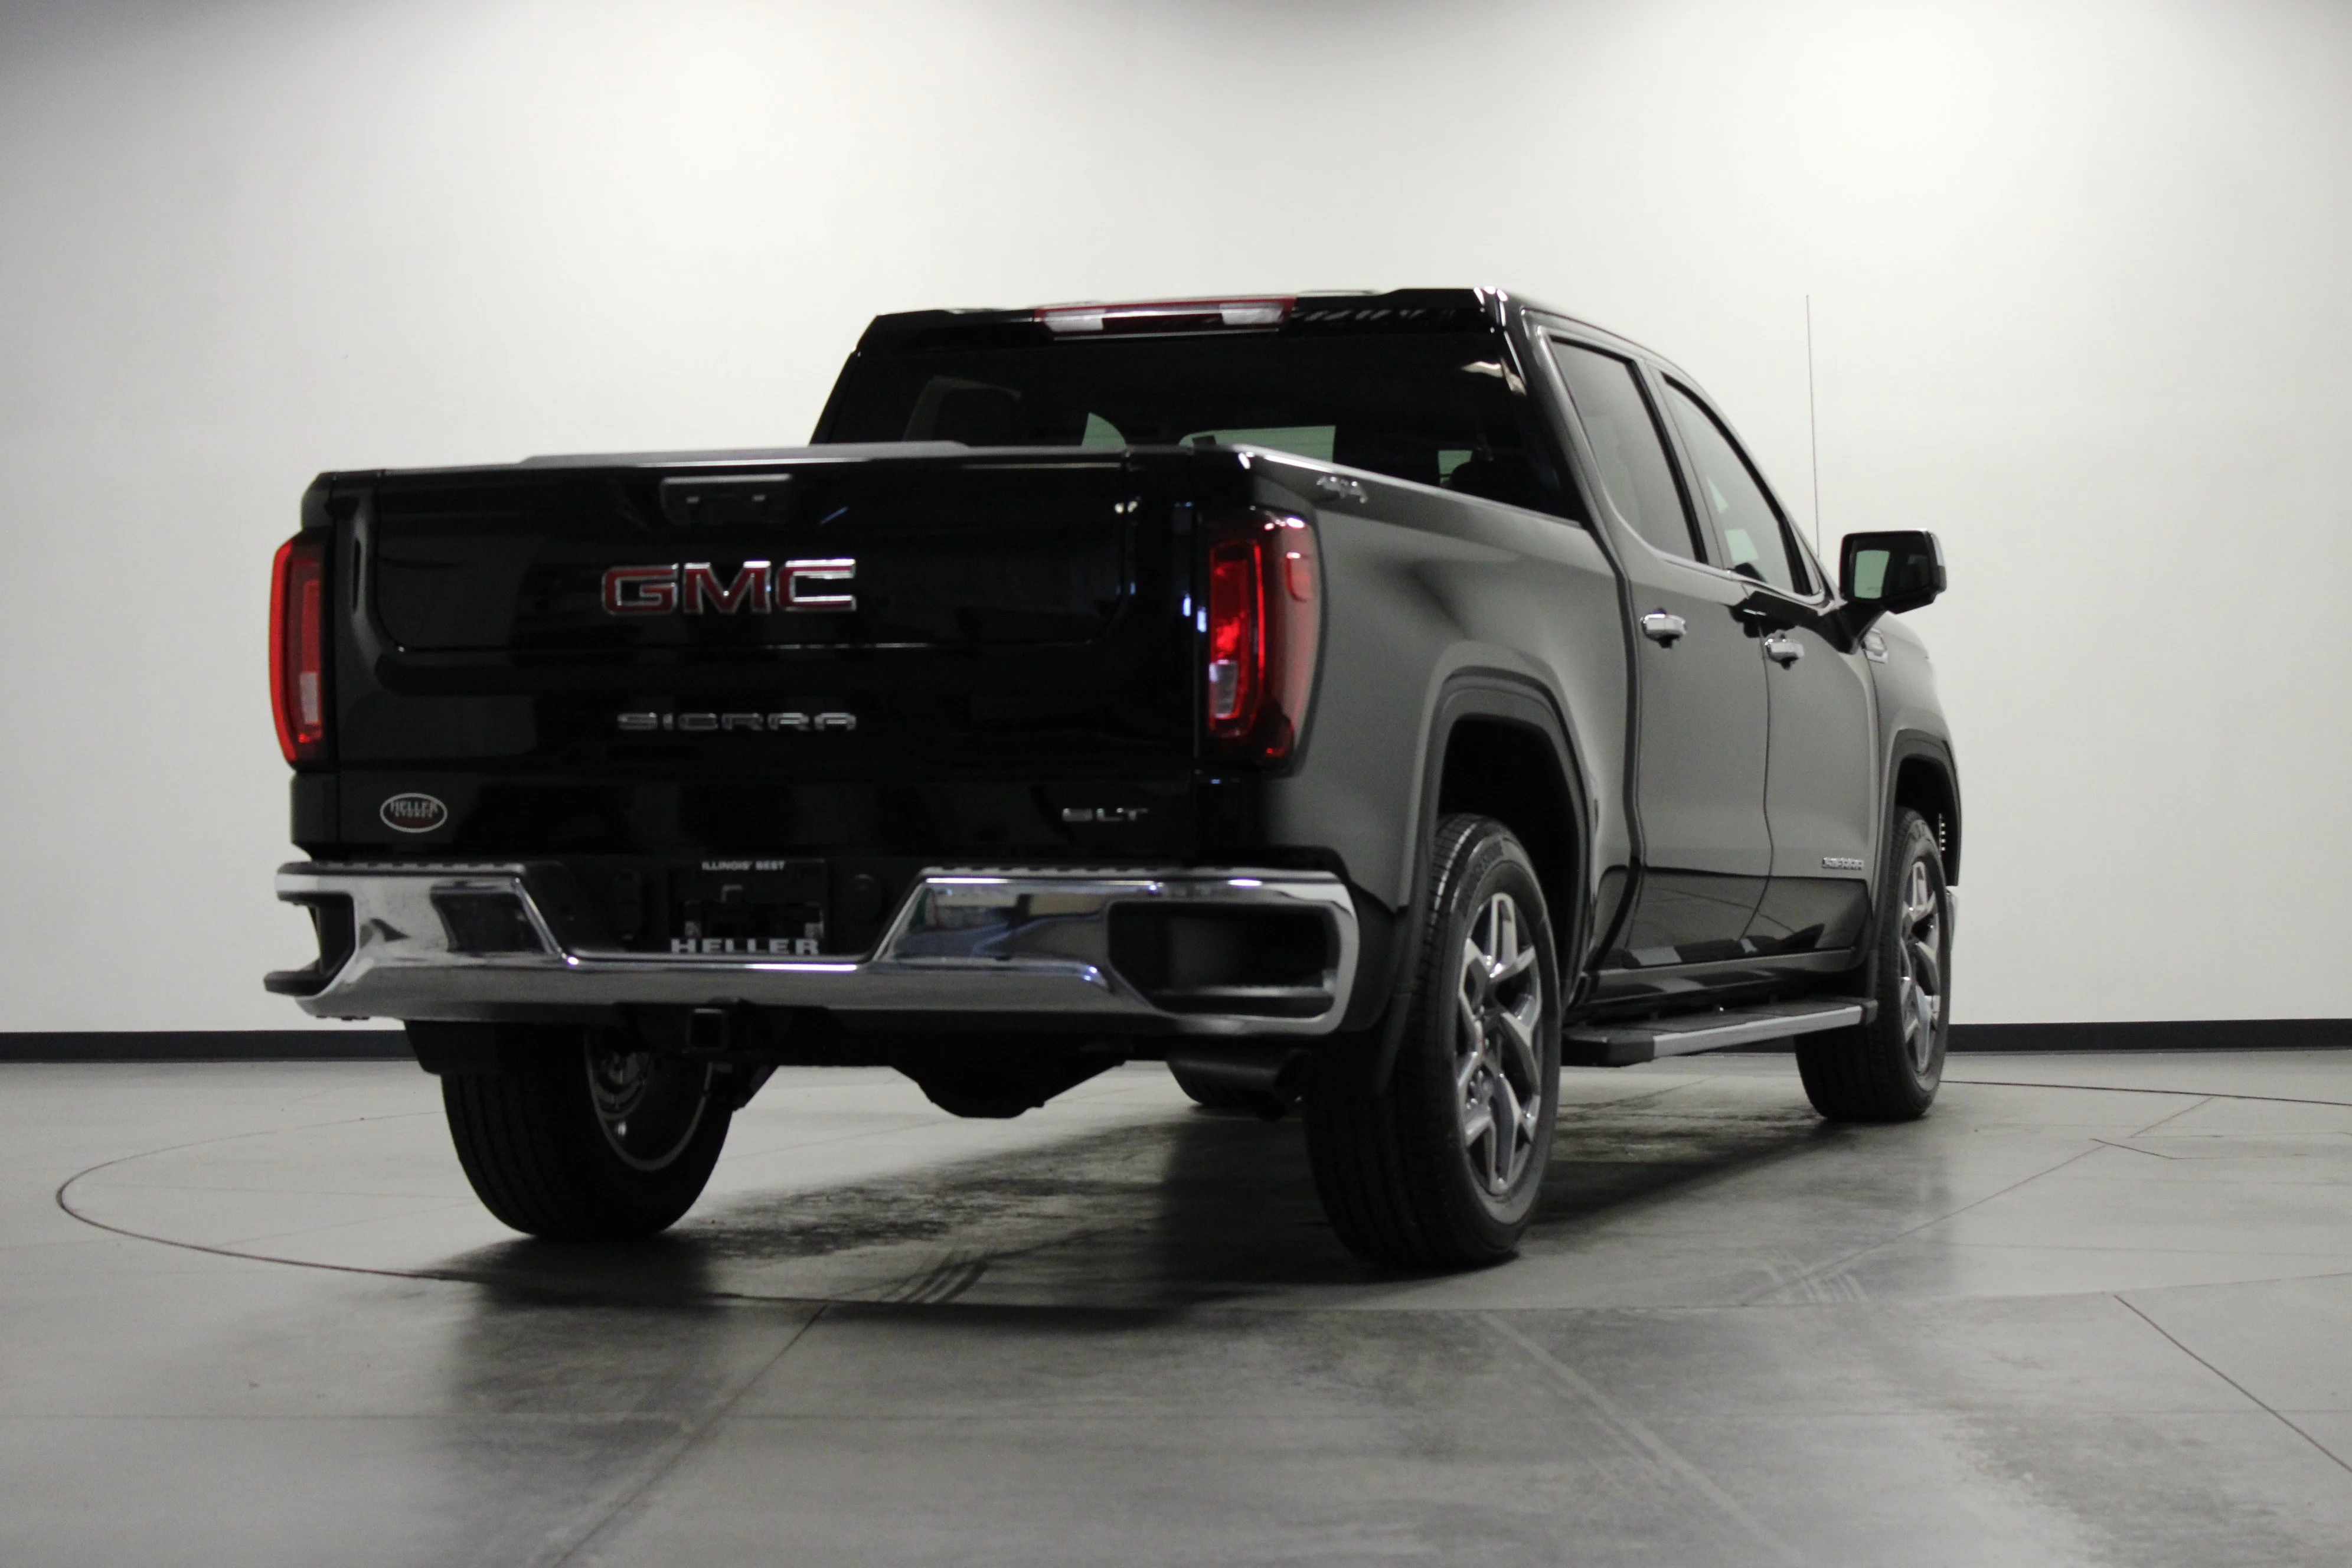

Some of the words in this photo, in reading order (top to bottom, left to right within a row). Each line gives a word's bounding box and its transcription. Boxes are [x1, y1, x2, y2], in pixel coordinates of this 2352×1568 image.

[601, 558, 857, 616] GMC
[617, 712, 856, 730] SIERRA
[1062, 808, 1149, 821] SLT
[756, 860, 785, 871] BEST
[671, 938, 819, 955] HELLER
